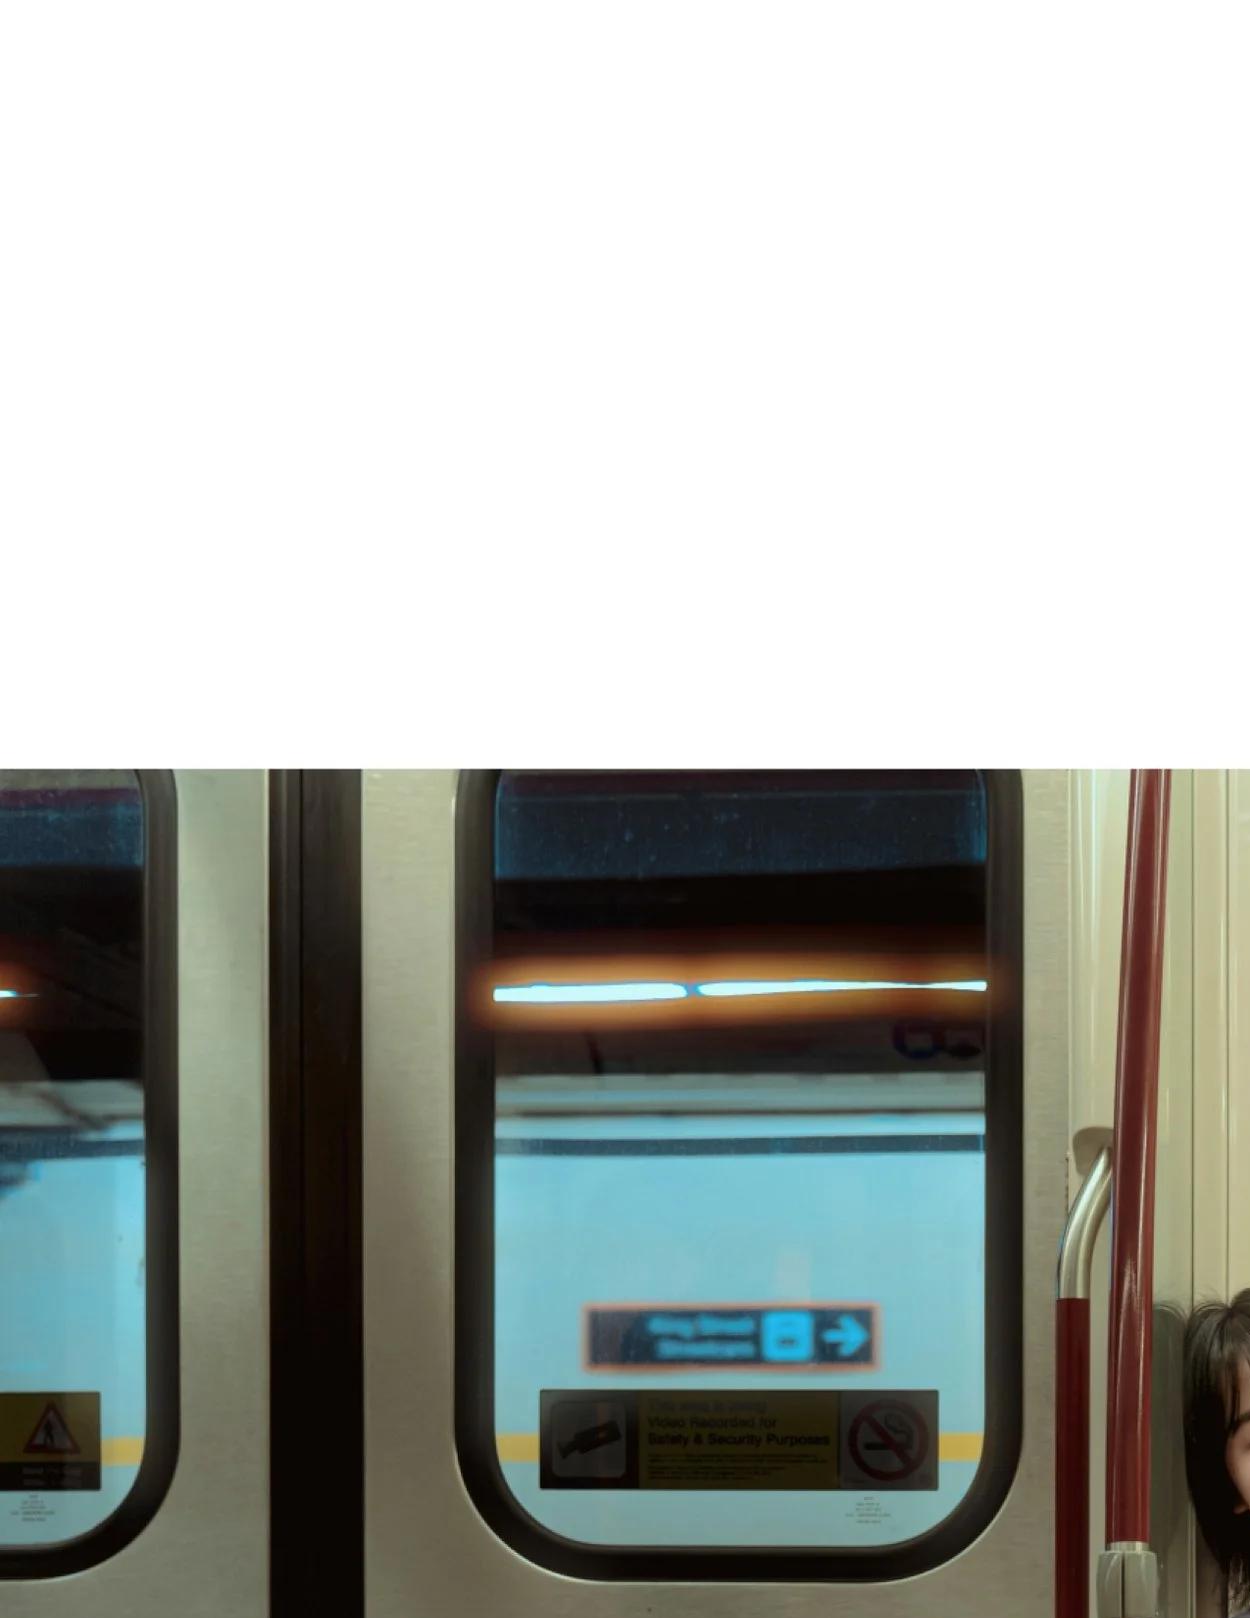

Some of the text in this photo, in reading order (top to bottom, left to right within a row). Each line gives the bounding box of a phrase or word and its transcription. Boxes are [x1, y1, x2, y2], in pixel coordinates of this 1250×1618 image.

[647, 1416, 685, 1429] Video
[647, 1432, 690, 1448] Safety
[707, 1432, 762, 1448] Security
[766, 1433, 831, 1448] Purposes
